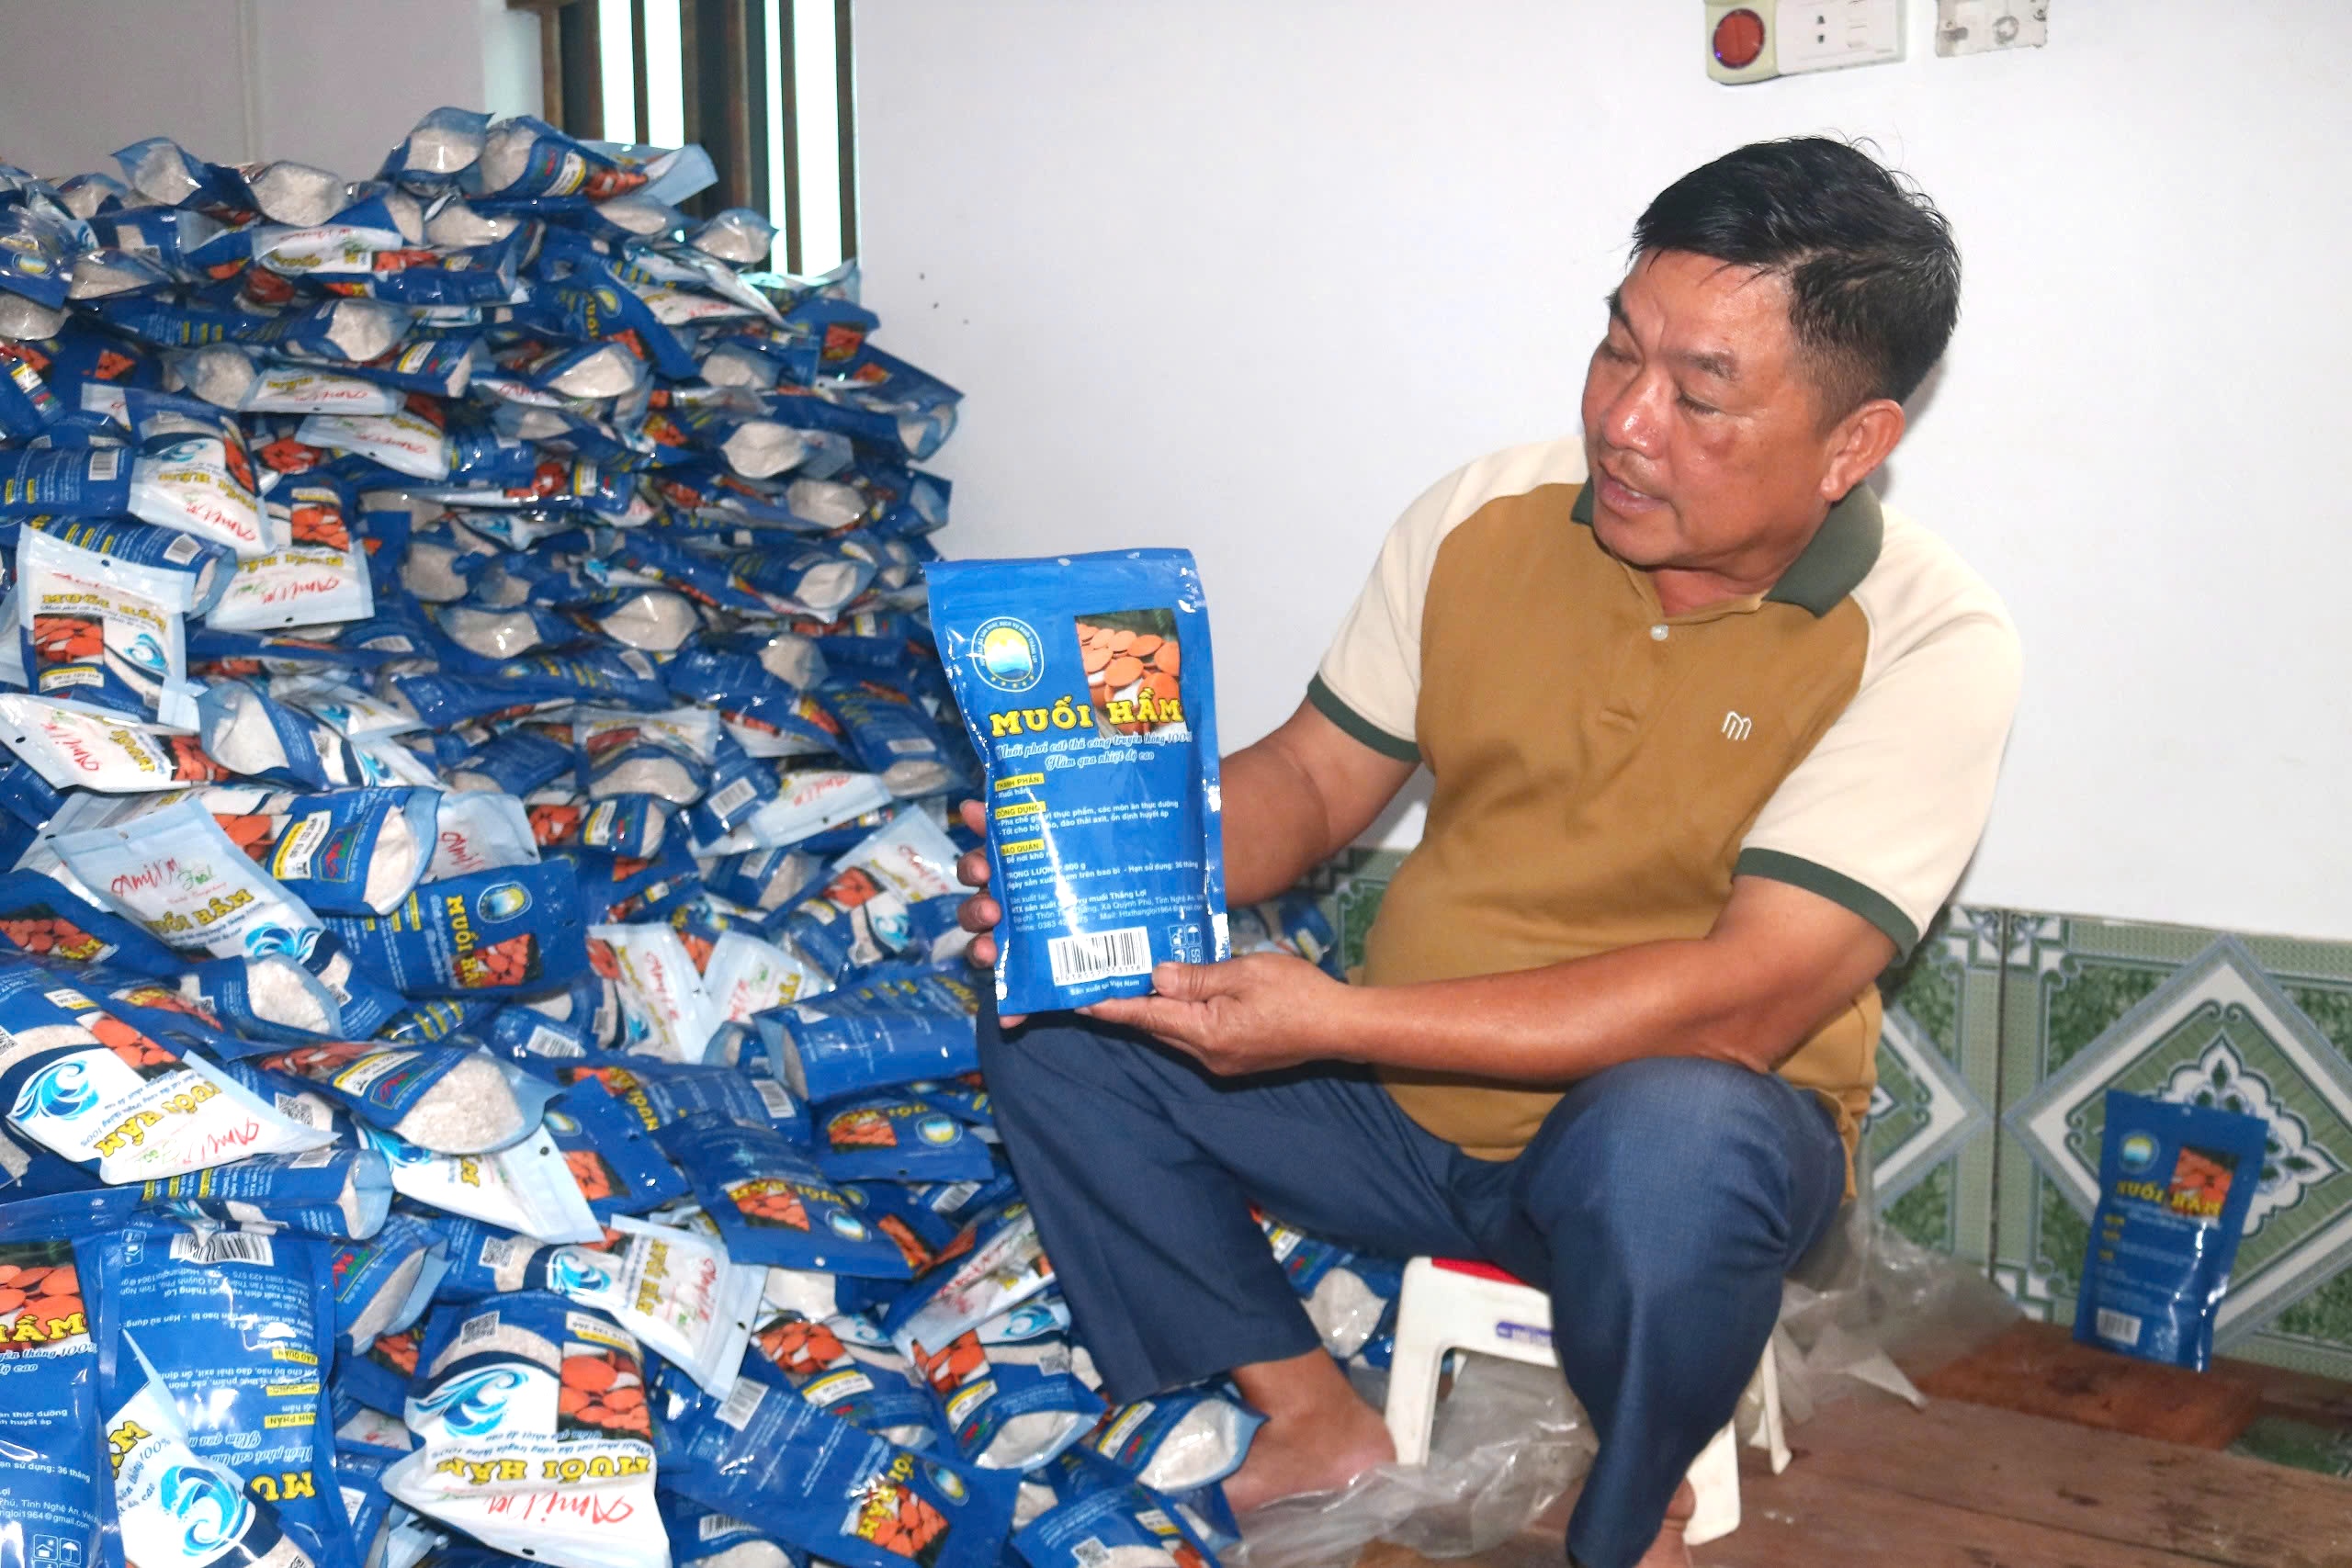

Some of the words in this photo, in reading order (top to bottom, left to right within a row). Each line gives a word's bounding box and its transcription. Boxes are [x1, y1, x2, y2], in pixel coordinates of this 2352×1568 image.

[989, 694, 1093, 737] MUỐI
[1106, 687, 1184, 725] HẦM
[1023, 740, 1048, 758] phơi
[1049, 738, 1068, 752] cát
[1069, 736, 1085, 750] thủ
[1087, 736, 1111, 750] công
[1077, 755, 1097, 769] qua
[1098, 749, 1125, 764] nhiệt
[1125, 748, 1137, 762] độ
[1138, 750, 1155, 761] cao
[58, 1342, 98, 1358] 100%
[13, 1362, 39, 1372] cao
[10, 1417, 38, 1427] huyết
[13, 1410, 34, 1419] thực
[37, 1408, 68, 1417] dưỡng
[15, 1461, 26, 1469] sử
[28, 1462, 55, 1473] dụng:
[57, 1465, 68, 1475] 36
[69, 1469, 91, 1483] tháng
[436, 1457, 528, 1486] HẦM
[542, 1456, 650, 1484] MUỐI
[251, 1471, 315, 1502] MU
[21, 1498, 41, 1508] Tỉnh
[43, 1500, 66, 1513] Nghệ
